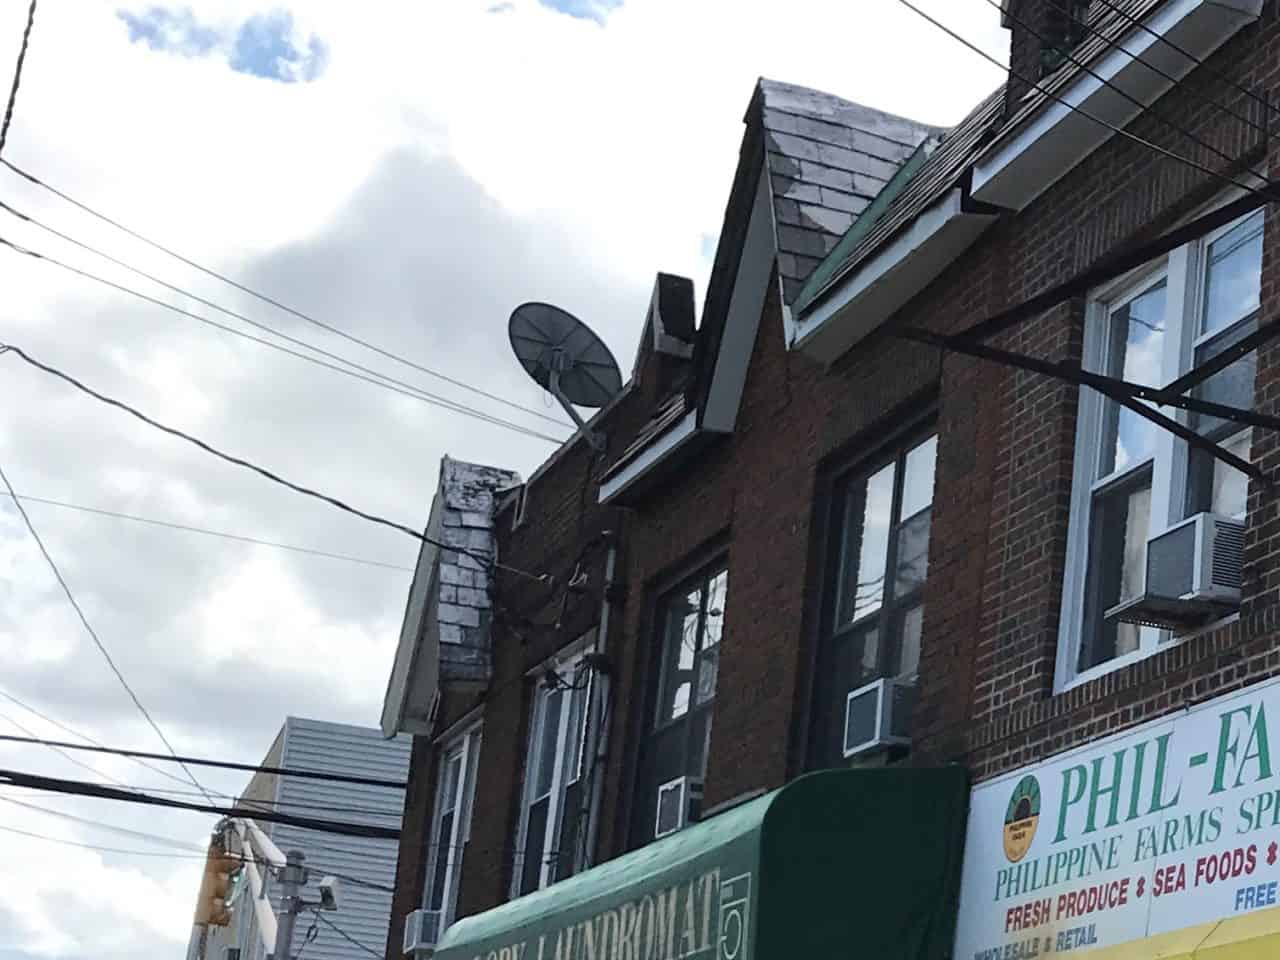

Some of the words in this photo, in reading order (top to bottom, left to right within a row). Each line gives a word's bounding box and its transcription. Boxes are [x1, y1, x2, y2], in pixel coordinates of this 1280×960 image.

[993, 835, 1122, 901] PHILIPPINE
[1134, 806, 1223, 862] FARMS
[1004, 898, 1051, 933] FRESH
[1056, 877, 1131, 921] PRODUCE
[1153, 863, 1186, 897] SEA
[1195, 844, 1257, 887] FOODS
[1234, 881, 1278, 910] FREE
[1056, 923, 1098, 952] RETAIL
